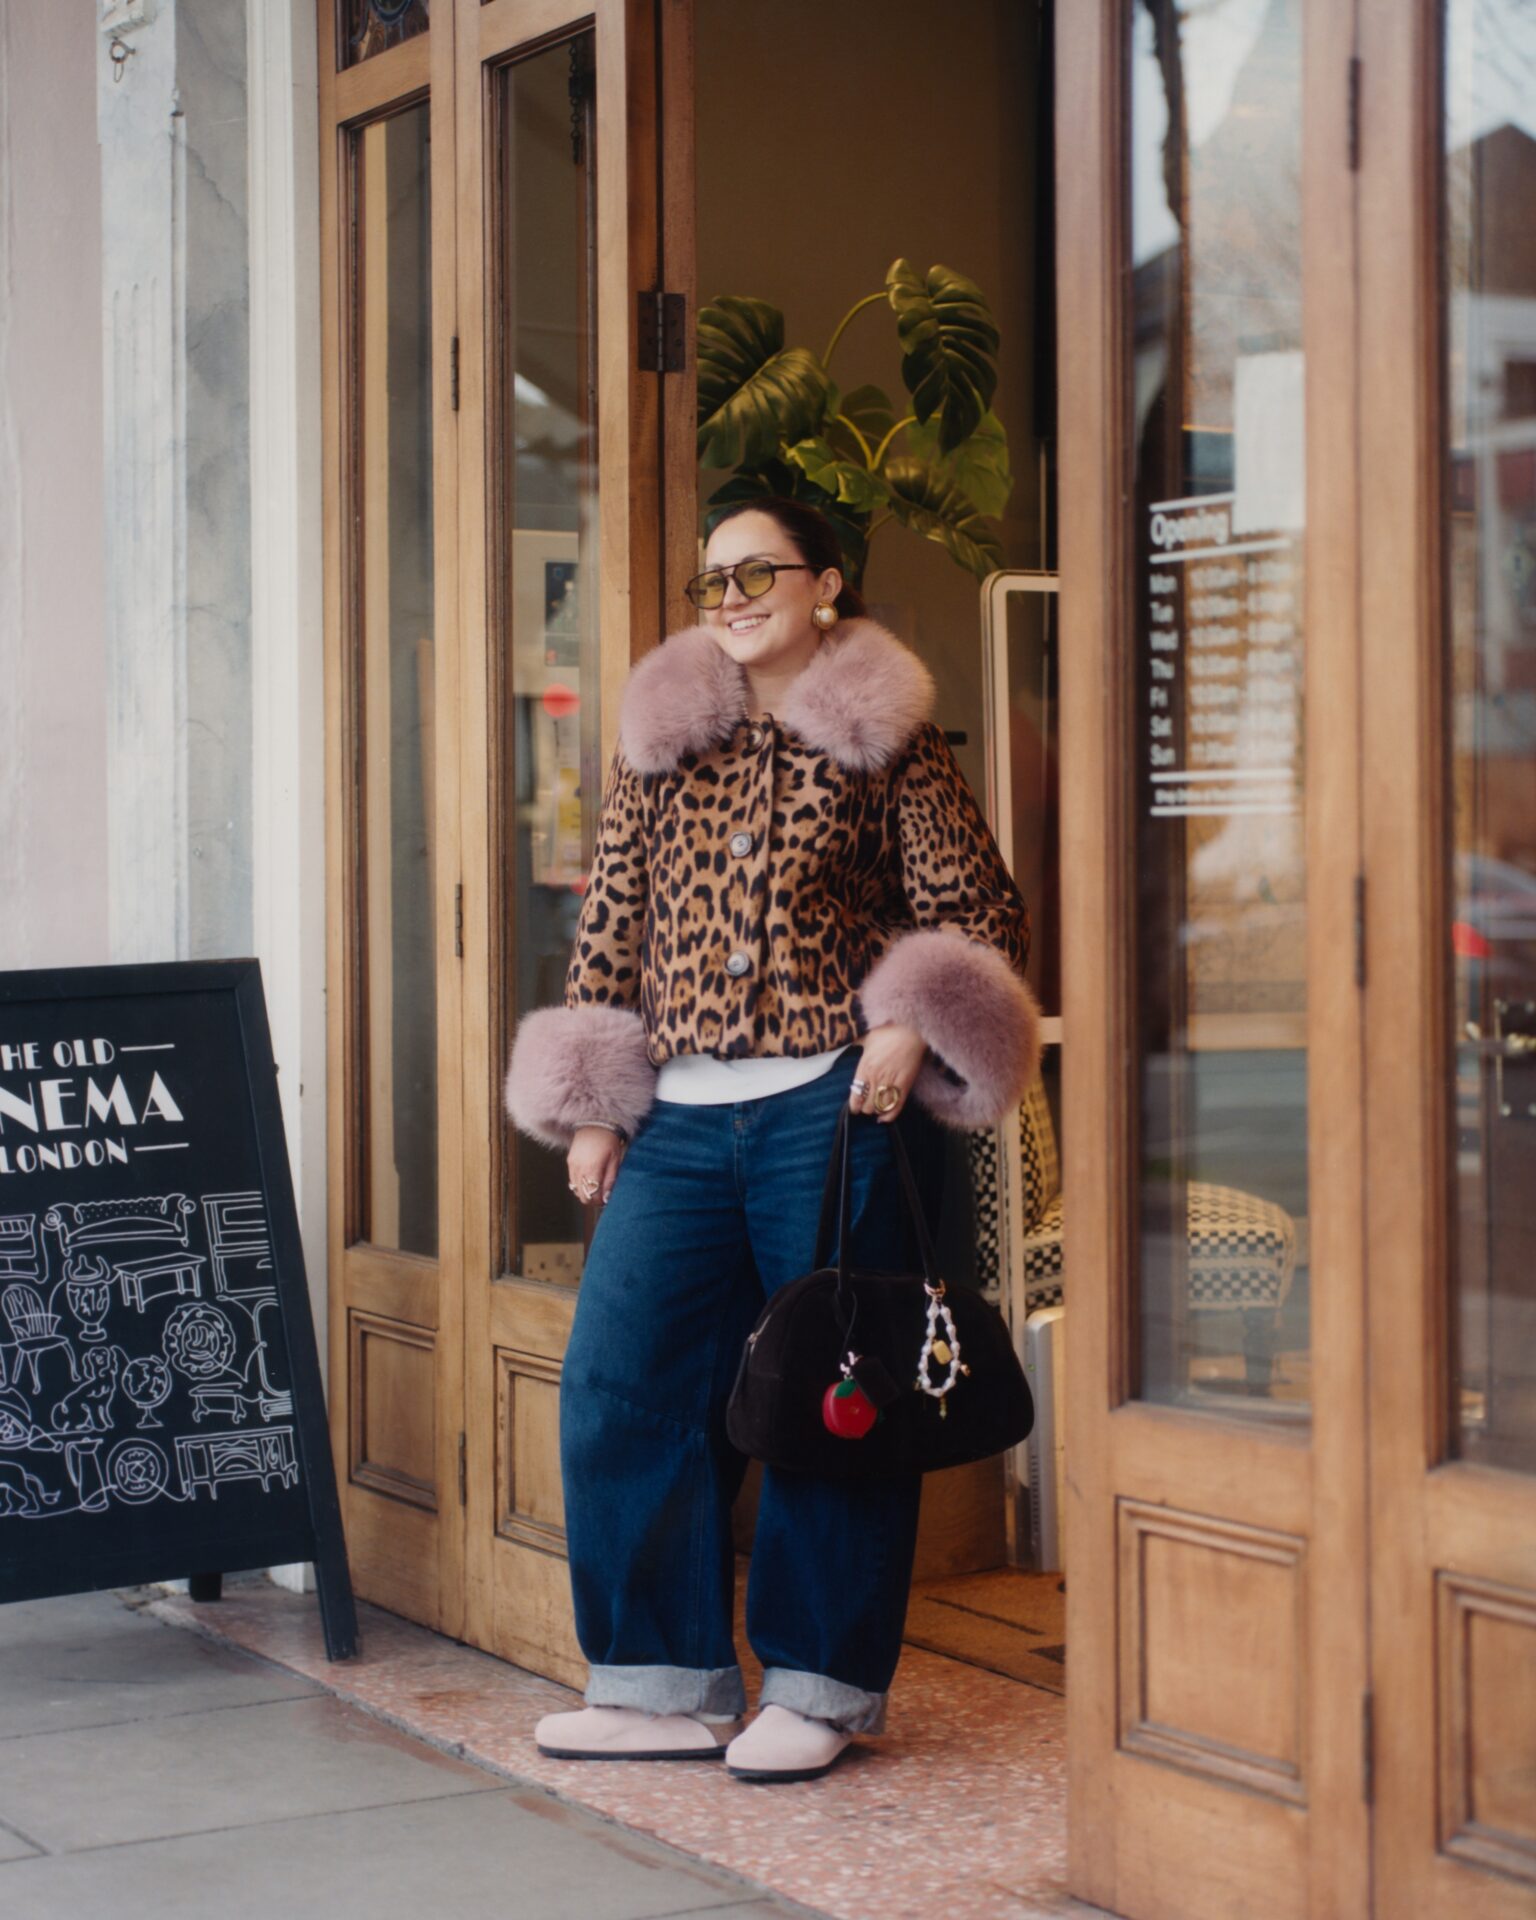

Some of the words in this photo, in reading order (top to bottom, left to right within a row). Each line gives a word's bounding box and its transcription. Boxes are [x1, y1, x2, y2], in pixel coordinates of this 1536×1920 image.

[1151, 507, 1230, 551] Opening
[53, 1038, 115, 1068] OLD
[0, 1070, 184, 1134] NEMA
[0, 1137, 128, 1173] LONDON
